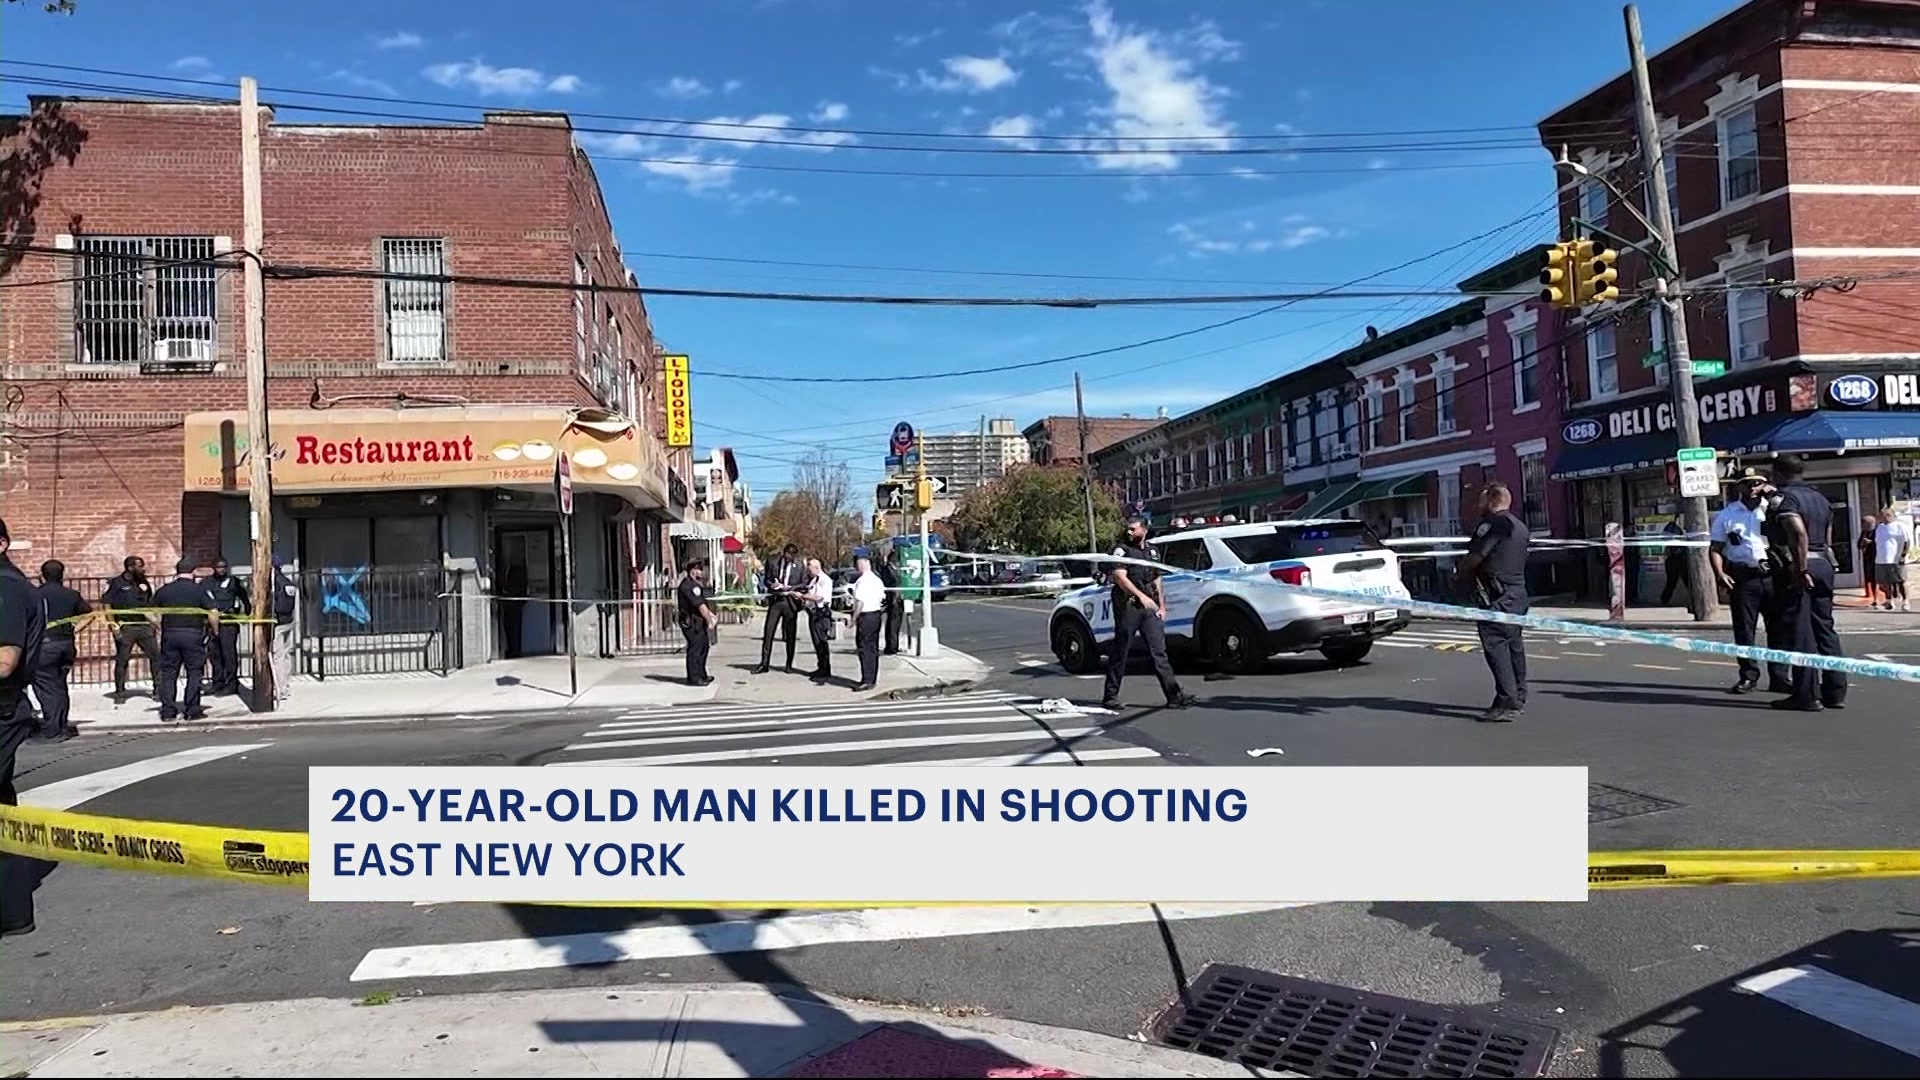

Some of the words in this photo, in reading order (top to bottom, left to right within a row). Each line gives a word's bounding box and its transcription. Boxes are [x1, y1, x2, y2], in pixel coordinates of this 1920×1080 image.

[671, 358, 685, 429] LIQUORS
[1838, 380, 1871, 399] 1268
[1608, 406, 1651, 438] DELI
[1656, 384, 1763, 431] GCERY
[1569, 422, 1597, 440] 1268
[295, 434, 474, 465] Restaurant
